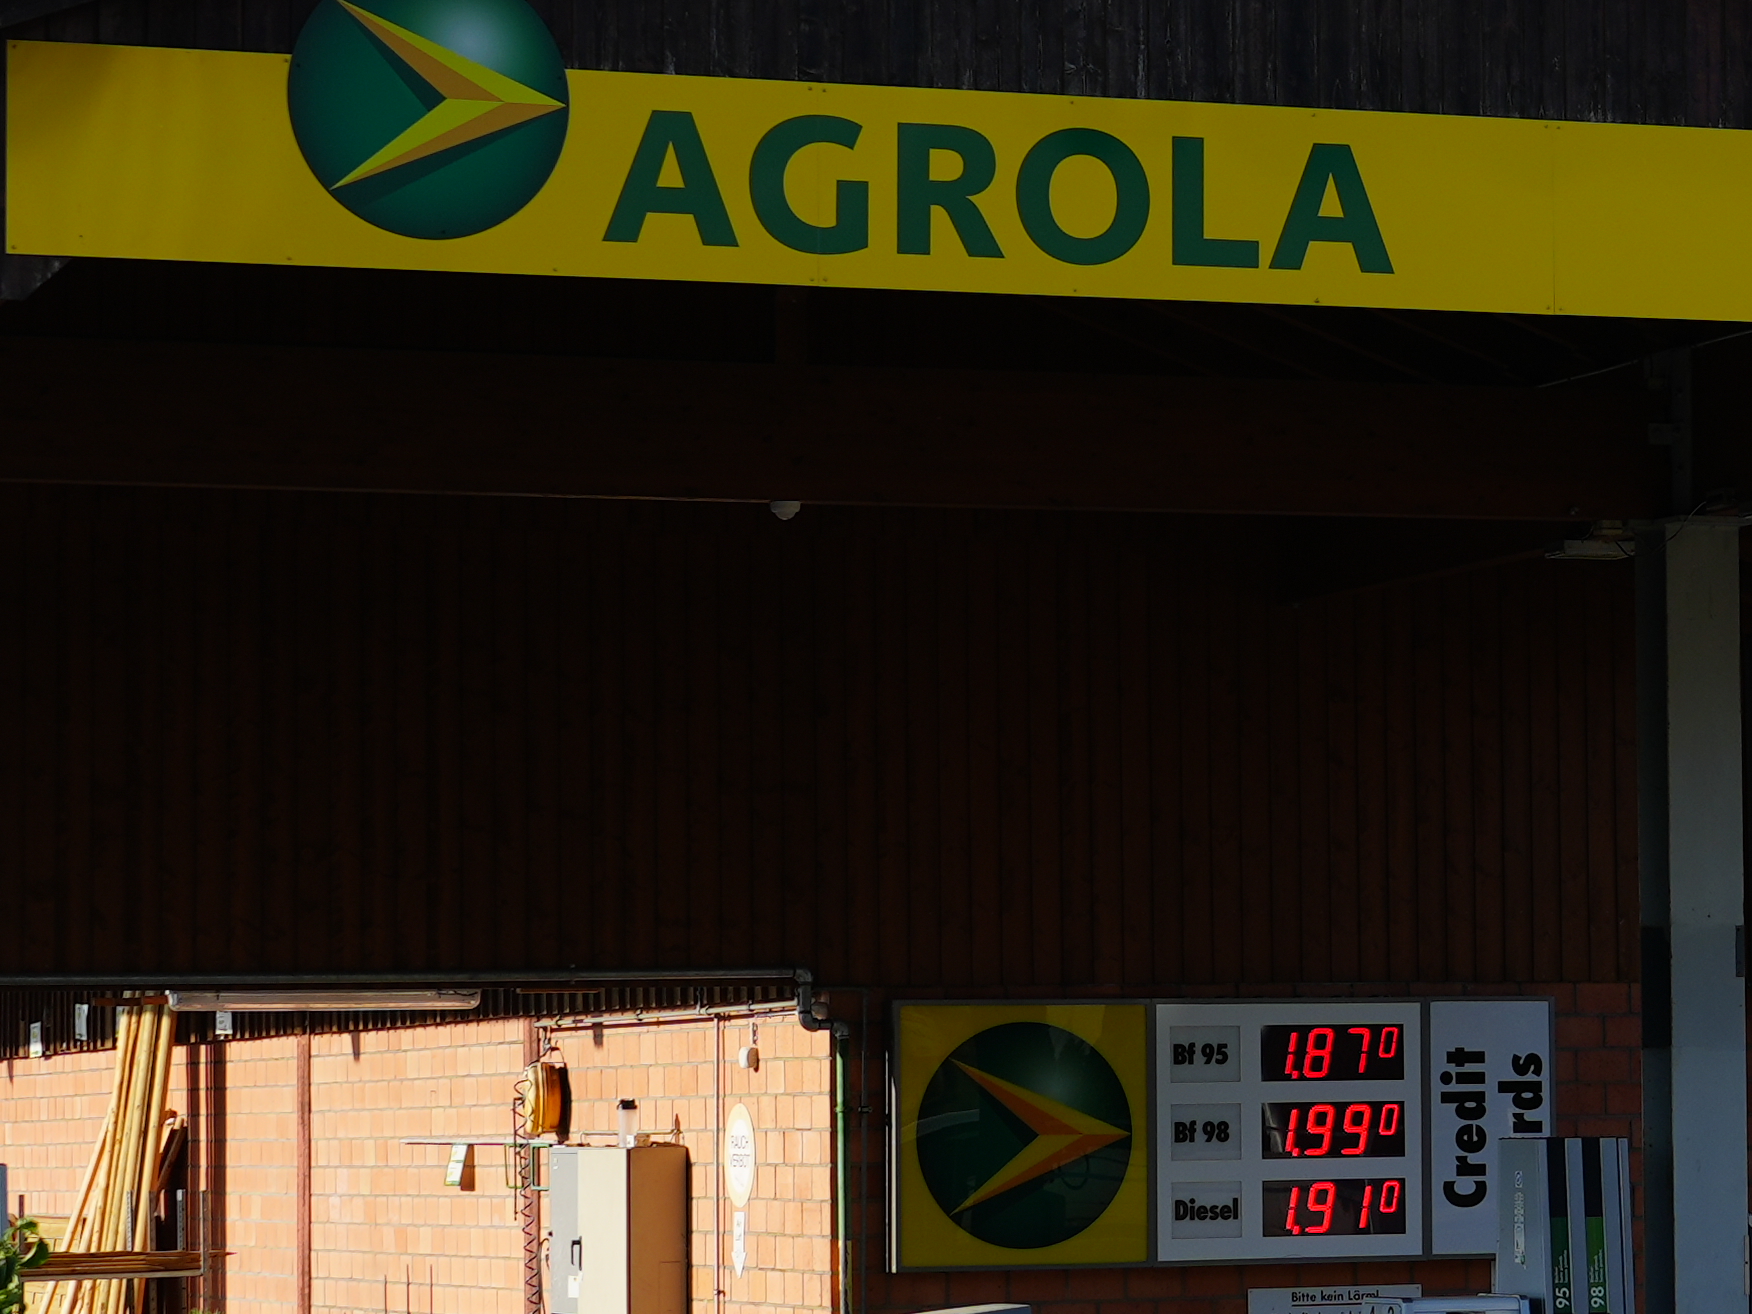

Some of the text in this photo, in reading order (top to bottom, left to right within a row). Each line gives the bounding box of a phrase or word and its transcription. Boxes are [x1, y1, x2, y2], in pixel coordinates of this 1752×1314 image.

[600, 109, 1396, 277] AGROLA
[1173, 1042, 1230, 1065] Bf 95
[1497, 1052, 1544, 1134] rds
[1174, 1121, 1231, 1143] Bf 98
[1439, 1047, 1488, 1208] Credit
[1174, 1196, 1239, 1221] Diesel
[1291, 1290, 1317, 1303] Bitte
[1320, 1289, 1344, 1302] kein
[1554, 1286, 1571, 1309] 95
[1589, 1285, 1606, 1308] 98
